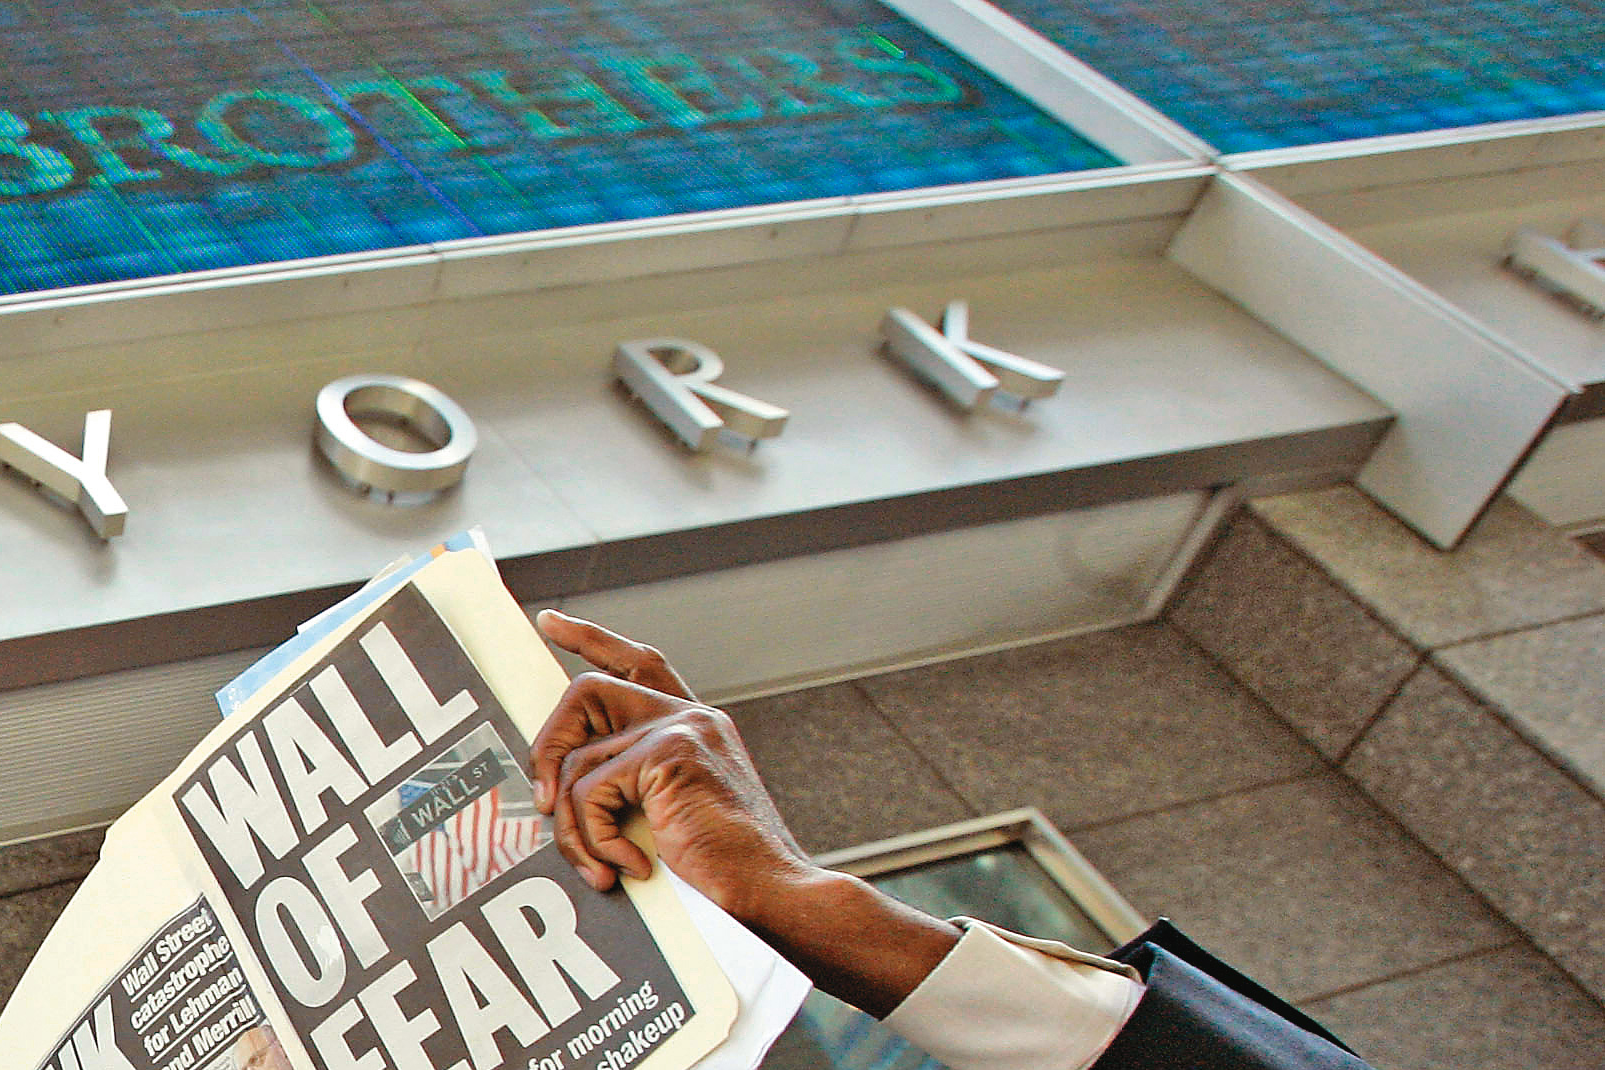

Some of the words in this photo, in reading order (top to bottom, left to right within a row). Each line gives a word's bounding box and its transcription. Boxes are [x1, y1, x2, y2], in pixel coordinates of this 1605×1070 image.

[179, 620, 480, 890] WALL
[410, 778, 480, 828] WALL
[473, 761, 488, 779] ST
[121, 955, 160, 997] Wall
[155, 907, 213, 963] Street
[255, 822, 391, 1008] OF
[130, 934, 231, 1030] catastrophe
[143, 1024, 172, 1057] for
[169, 966, 244, 1034] Lehman
[191, 994, 257, 1056] Merrill
[566, 979, 660, 1061] morning
